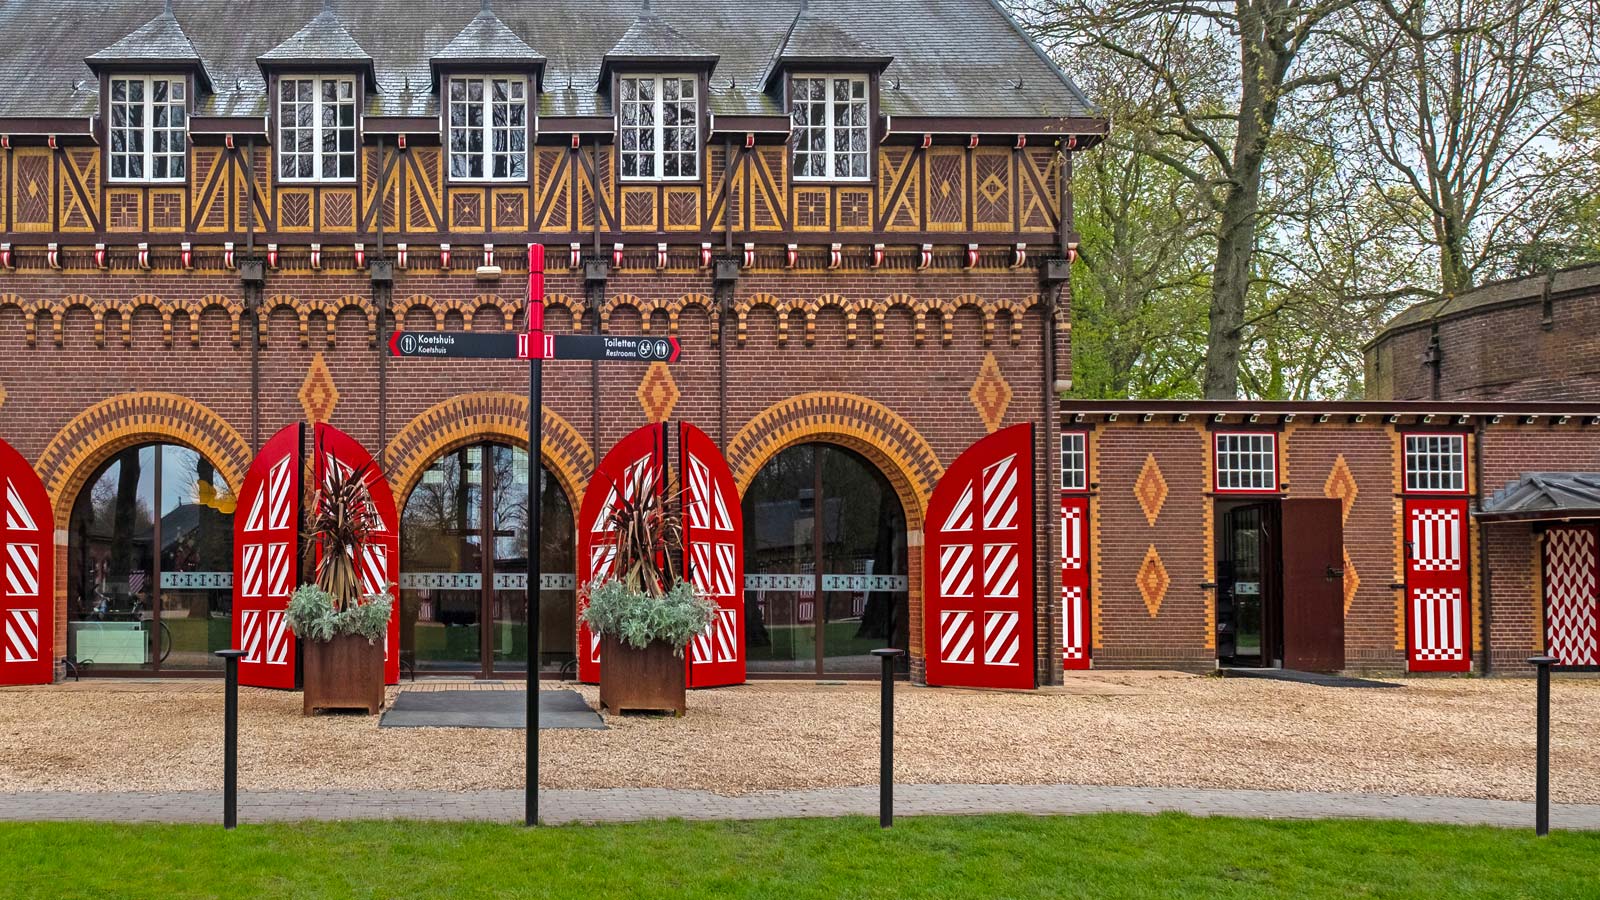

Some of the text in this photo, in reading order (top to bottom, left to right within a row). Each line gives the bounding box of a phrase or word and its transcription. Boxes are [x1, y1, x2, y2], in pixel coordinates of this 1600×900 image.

[418, 334, 455, 344] Koetshuis
[604, 338, 637, 347] Toiletten
[418, 345, 447, 354] Koetshuis
[606, 349, 637, 357] Restrooms
